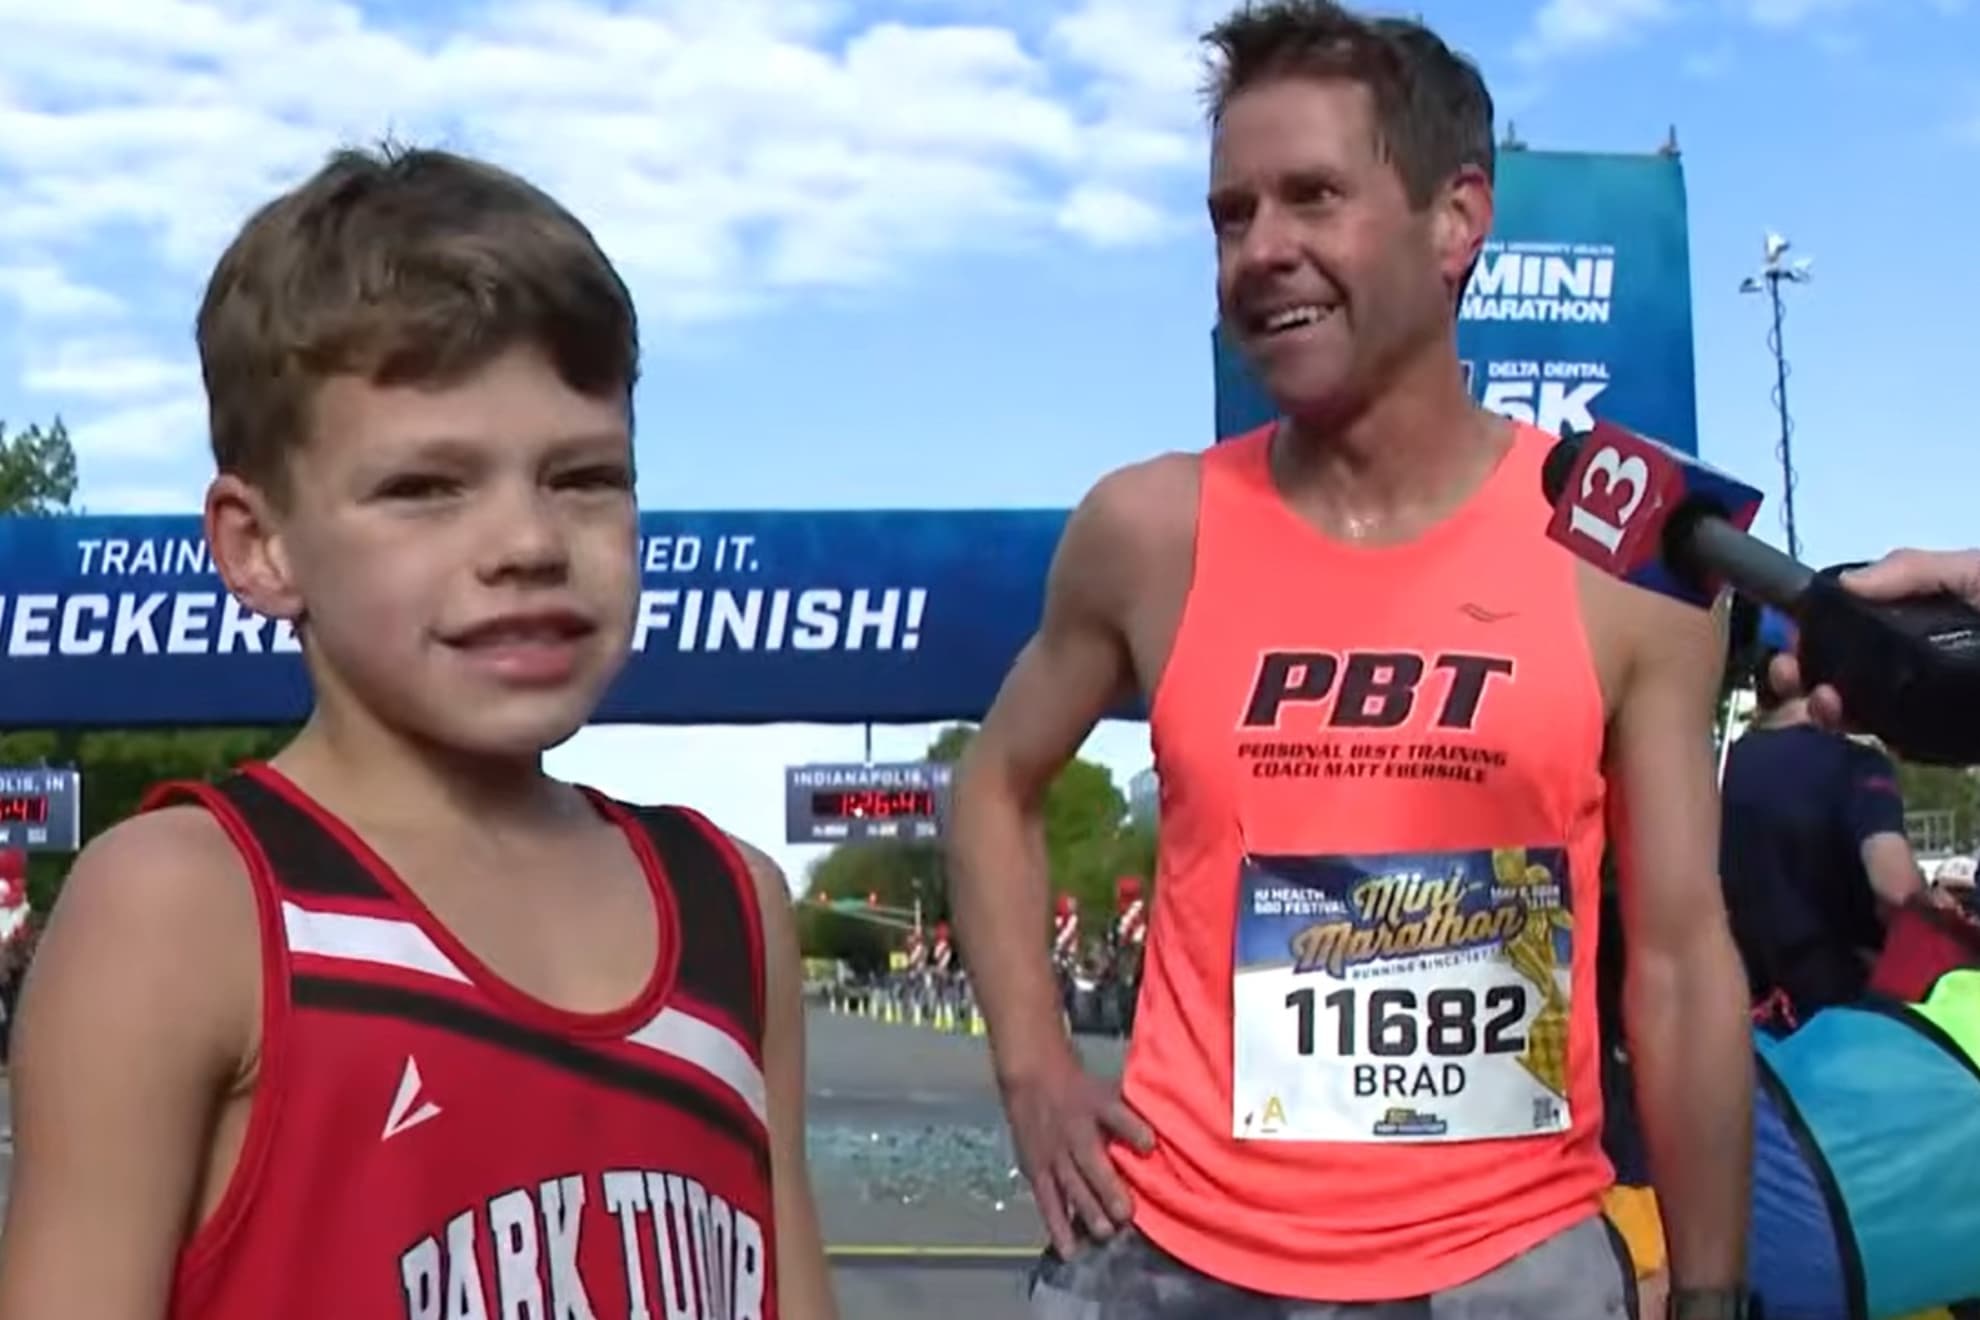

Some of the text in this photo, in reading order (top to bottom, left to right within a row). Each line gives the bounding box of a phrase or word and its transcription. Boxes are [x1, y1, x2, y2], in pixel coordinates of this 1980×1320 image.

[1464, 253, 1614, 298] MINI
[1459, 296, 1610, 323] MARATHON
[1488, 361, 1610, 379] DELTA DENTAL
[1482, 381, 1608, 438] 5K
[1569, 446, 1648, 555] 13
[77, 535, 758, 576] TRAIN ED IT.
[0, 588, 928, 657] ECKER FINISH!
[1237, 648, 1515, 732] PBT
[1238, 743, 1507, 768] PERSONAL BEST TRAINING
[1253, 761, 1321, 778] COACH
[1323, 762, 1380, 779] MATT
[1271, 887, 1326, 901] HEALTH
[1284, 900, 1348, 915] FESTIVAL
[1290, 904, 1526, 981] Marathon
[1285, 983, 1527, 1057] 11682
[1353, 1063, 1467, 1098] BRAD
[1262, 1095, 1288, 1126] A
[401, 1173, 600, 1320] PARK
